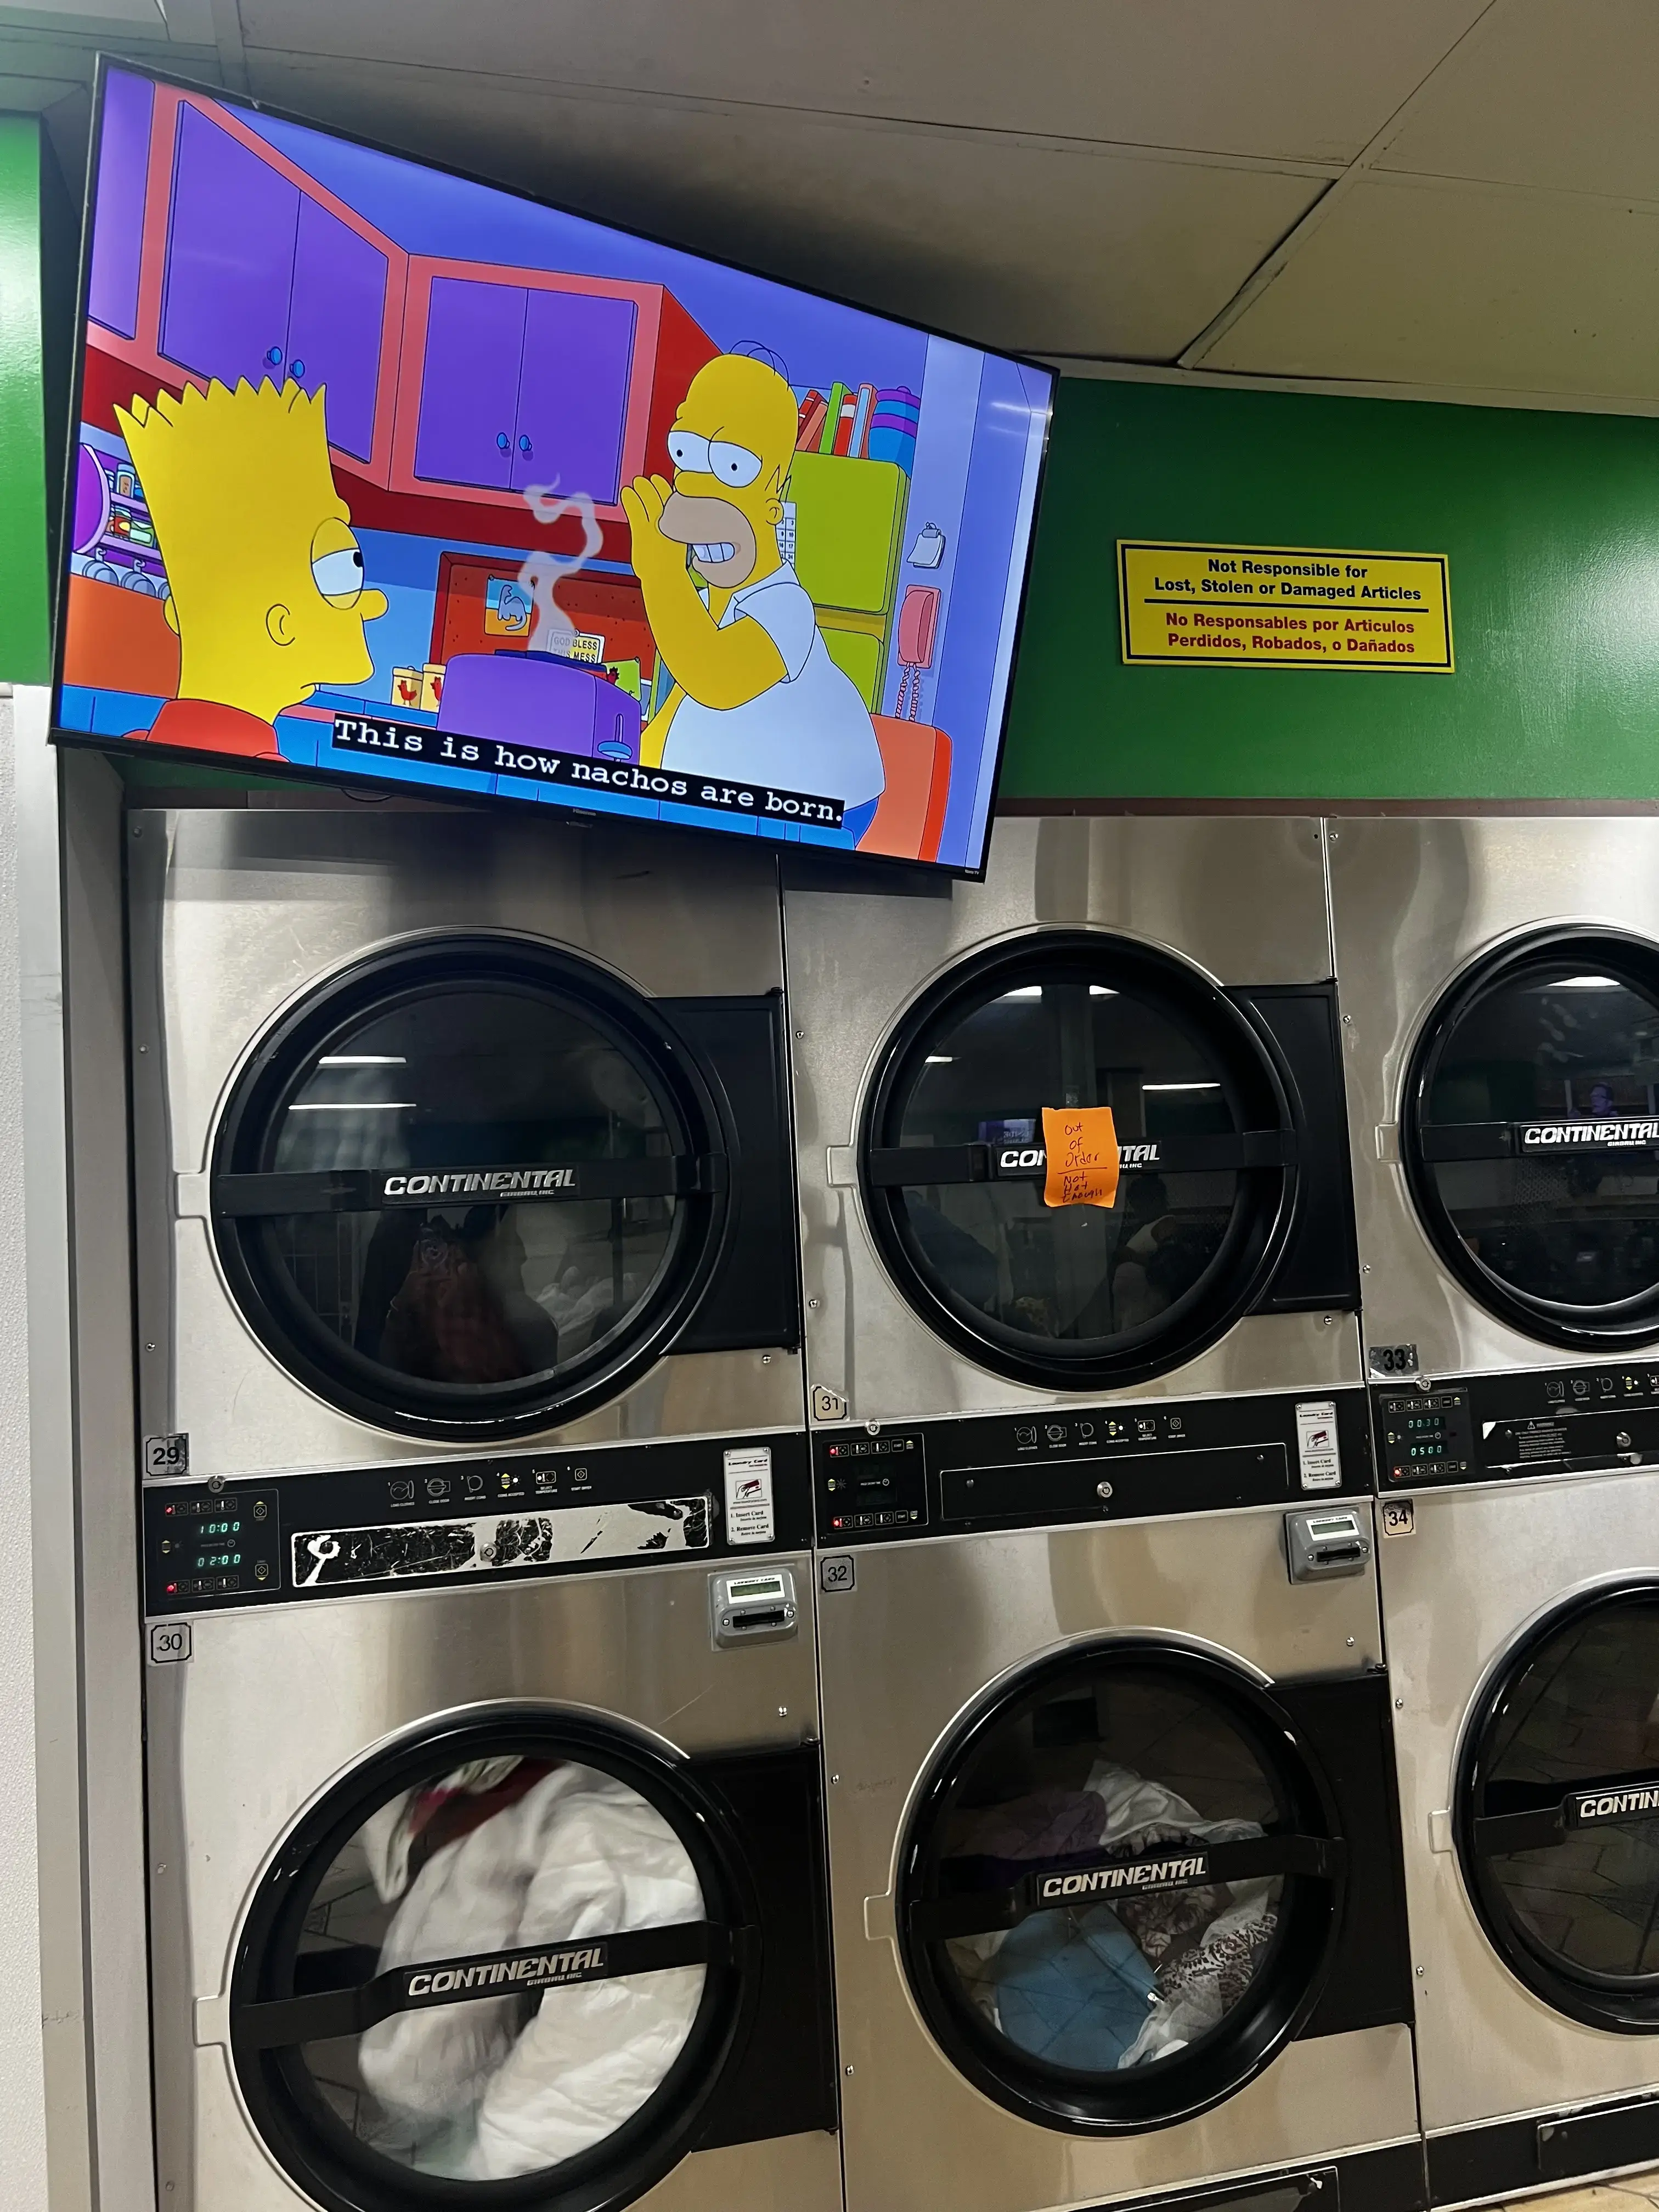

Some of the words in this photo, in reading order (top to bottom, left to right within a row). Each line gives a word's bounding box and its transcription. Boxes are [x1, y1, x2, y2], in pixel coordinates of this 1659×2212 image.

[1208, 559, 1237, 574] Not
[1242, 561, 1340, 578] Responsible
[1345, 565, 1368, 578] for
[1154, 577, 1196, 595] Lost,
[1201, 579, 1253, 594] Stolen
[1259, 583, 1276, 595] or
[1281, 582, 1356, 599] Damaged
[1361, 586, 1421, 601] Articles
[1166, 612, 1188, 627] No
[1194, 613, 1307, 630] Responsables
[1313, 619, 1339, 633] por
[1344, 618, 1414, 634] Articulos
[554, 636, 571, 646] GOD
[572, 639, 597, 651] BLESS
[1168, 633, 1246, 651] Perdidos,
[1252, 636, 1327, 653] Robados,
[1332, 641, 1341, 652] o
[1347, 637, 1415, 653] Dañados
[574, 651, 596, 663] MESS
[334, 718, 424, 752] This
[440, 737, 480, 761] is
[496, 745, 560, 774] how
[572, 759, 687, 795] nachos
[701, 782, 754, 808] are
[765, 791, 843, 822] born.
[1065, 1122, 1084, 1135] Out
[1524, 1122, 1659, 1144] CONTINENTAL
[1065, 1152, 1099, 1167] Order
[384, 1169, 575, 1195] CONTINENTAL
[1064, 1171, 1088, 1186] Not
[1064, 1181, 1087, 1195] Hot
[1383, 1348, 1406, 1370] 33
[821, 1396, 839, 1411] 31
[153, 1446, 180, 1465] 29
[1389, 1509, 1408, 1527] 34
[198, 1554, 241, 1567] 02:00
[827, 1566, 848, 1582] 32
[159, 1633, 183, 1652] 30
[1580, 1790, 1659, 1818] CONTIN
[1043, 1857, 1206, 1898] CONTINENTAL
[408, 1948, 603, 1996] CONTINENTAL
